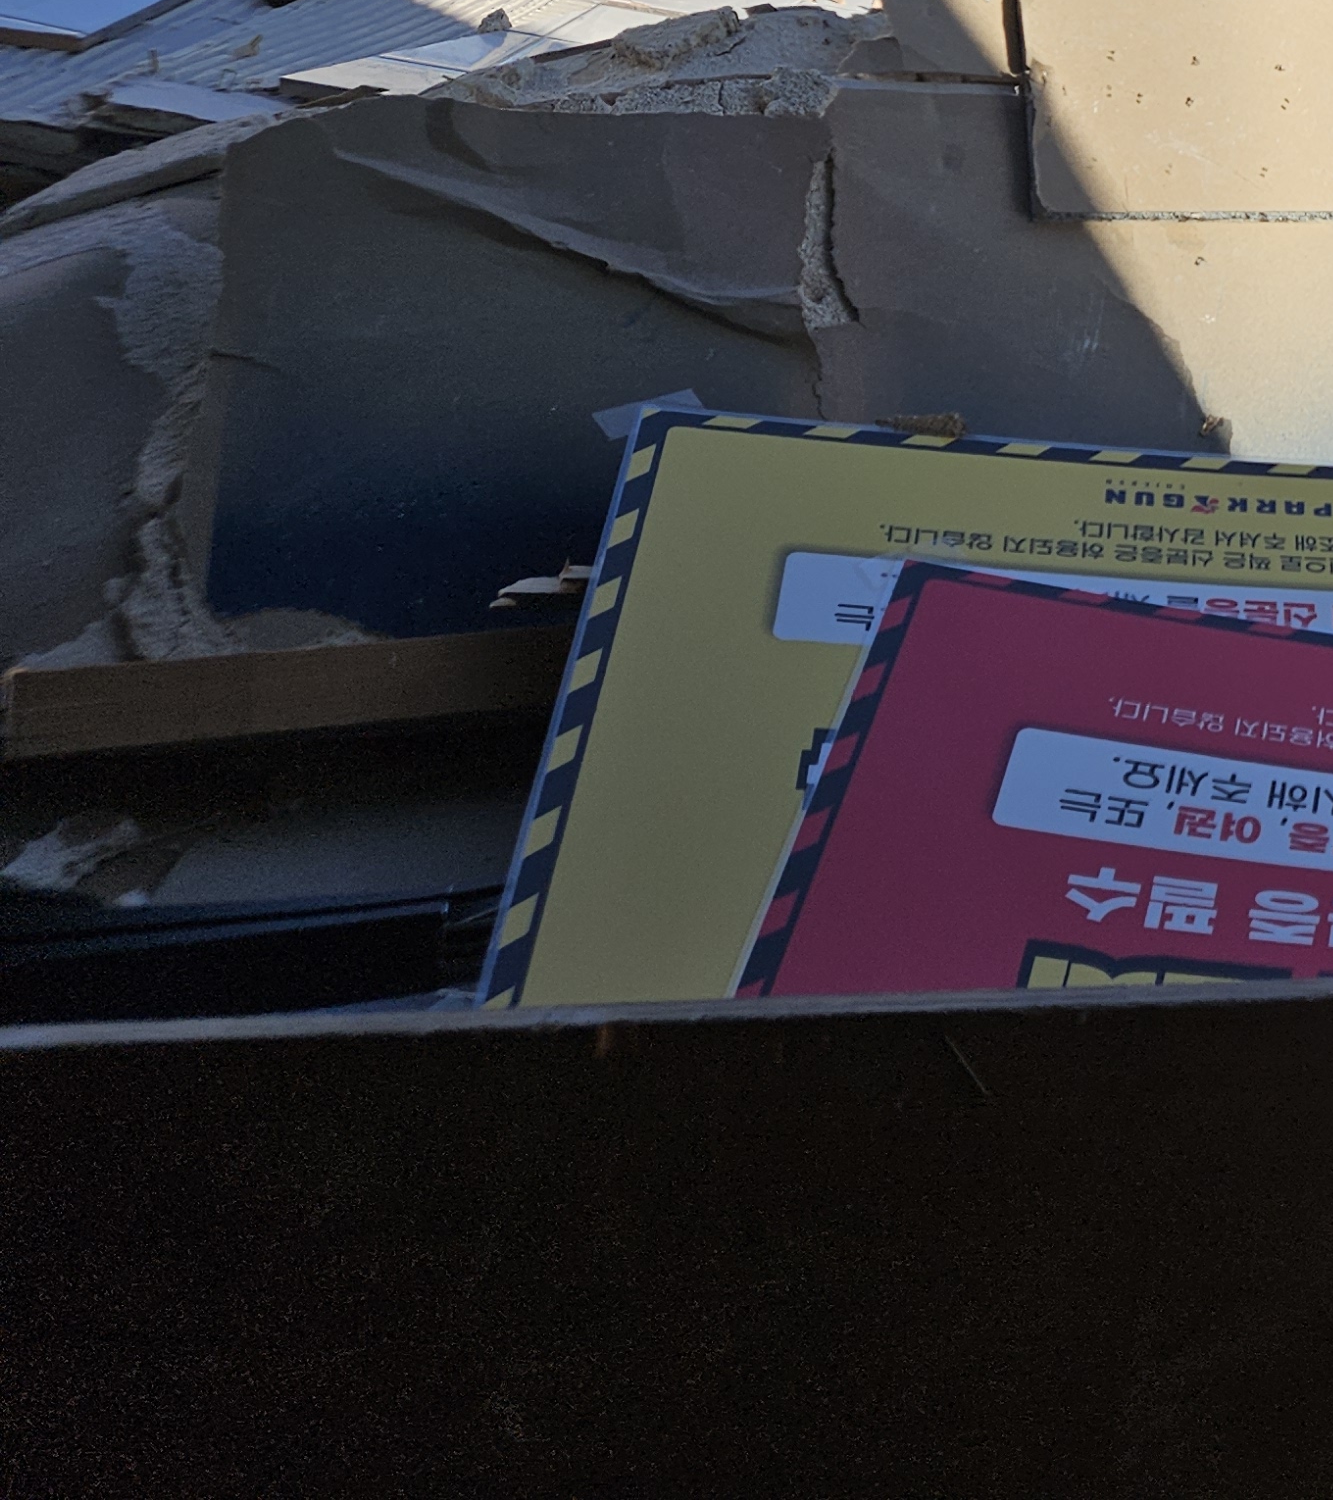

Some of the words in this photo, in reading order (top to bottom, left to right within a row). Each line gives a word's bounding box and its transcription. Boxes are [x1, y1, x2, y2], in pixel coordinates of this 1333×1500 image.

[1104, 488, 1185, 509] GUN
[1226, 497, 1332, 518] PARK
[879, 523, 992, 552] 않습니다.
[1073, 519, 1205, 545] 감사합니다.
[1213, 529, 1286, 549] 주셔서
[1002, 534, 1104, 560] 허용되지
[1114, 544, 1214, 568] 신분증은
[1223, 551, 1271, 572] 찍은
[1111, 756, 1252, 805] 주세요.
[1058, 788, 1149, 829] 또는
[1165, 800, 1263, 845] 여권,
[1064, 866, 1218, 936] 필수
